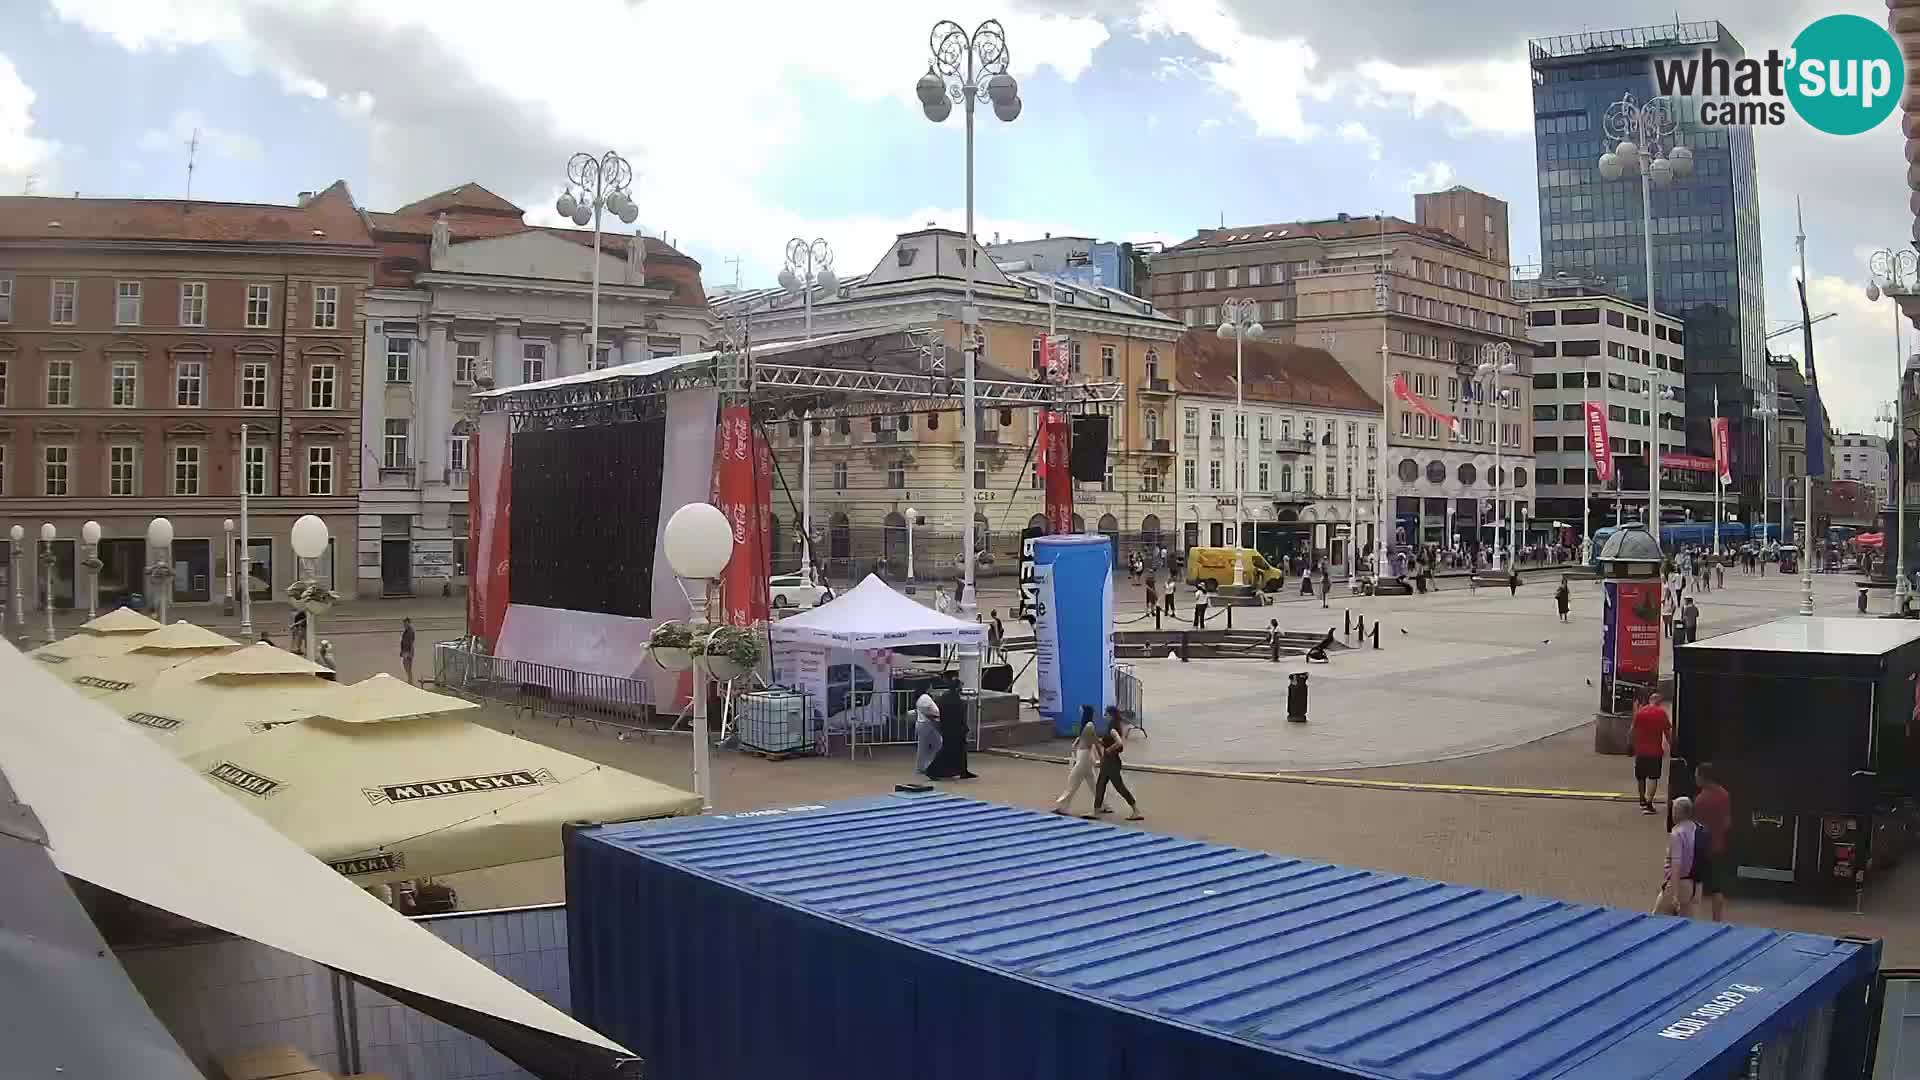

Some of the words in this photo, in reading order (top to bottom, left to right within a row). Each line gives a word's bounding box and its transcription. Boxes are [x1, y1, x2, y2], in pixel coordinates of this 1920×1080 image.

[735, 417, 748, 461] Coca-Cola
[734, 502, 746, 545] Coca-Cola
[395, 774, 532, 799] MARASKA
[336, 857, 390, 874] RASKA
[1691, 990, 1747, 1019] 300629
